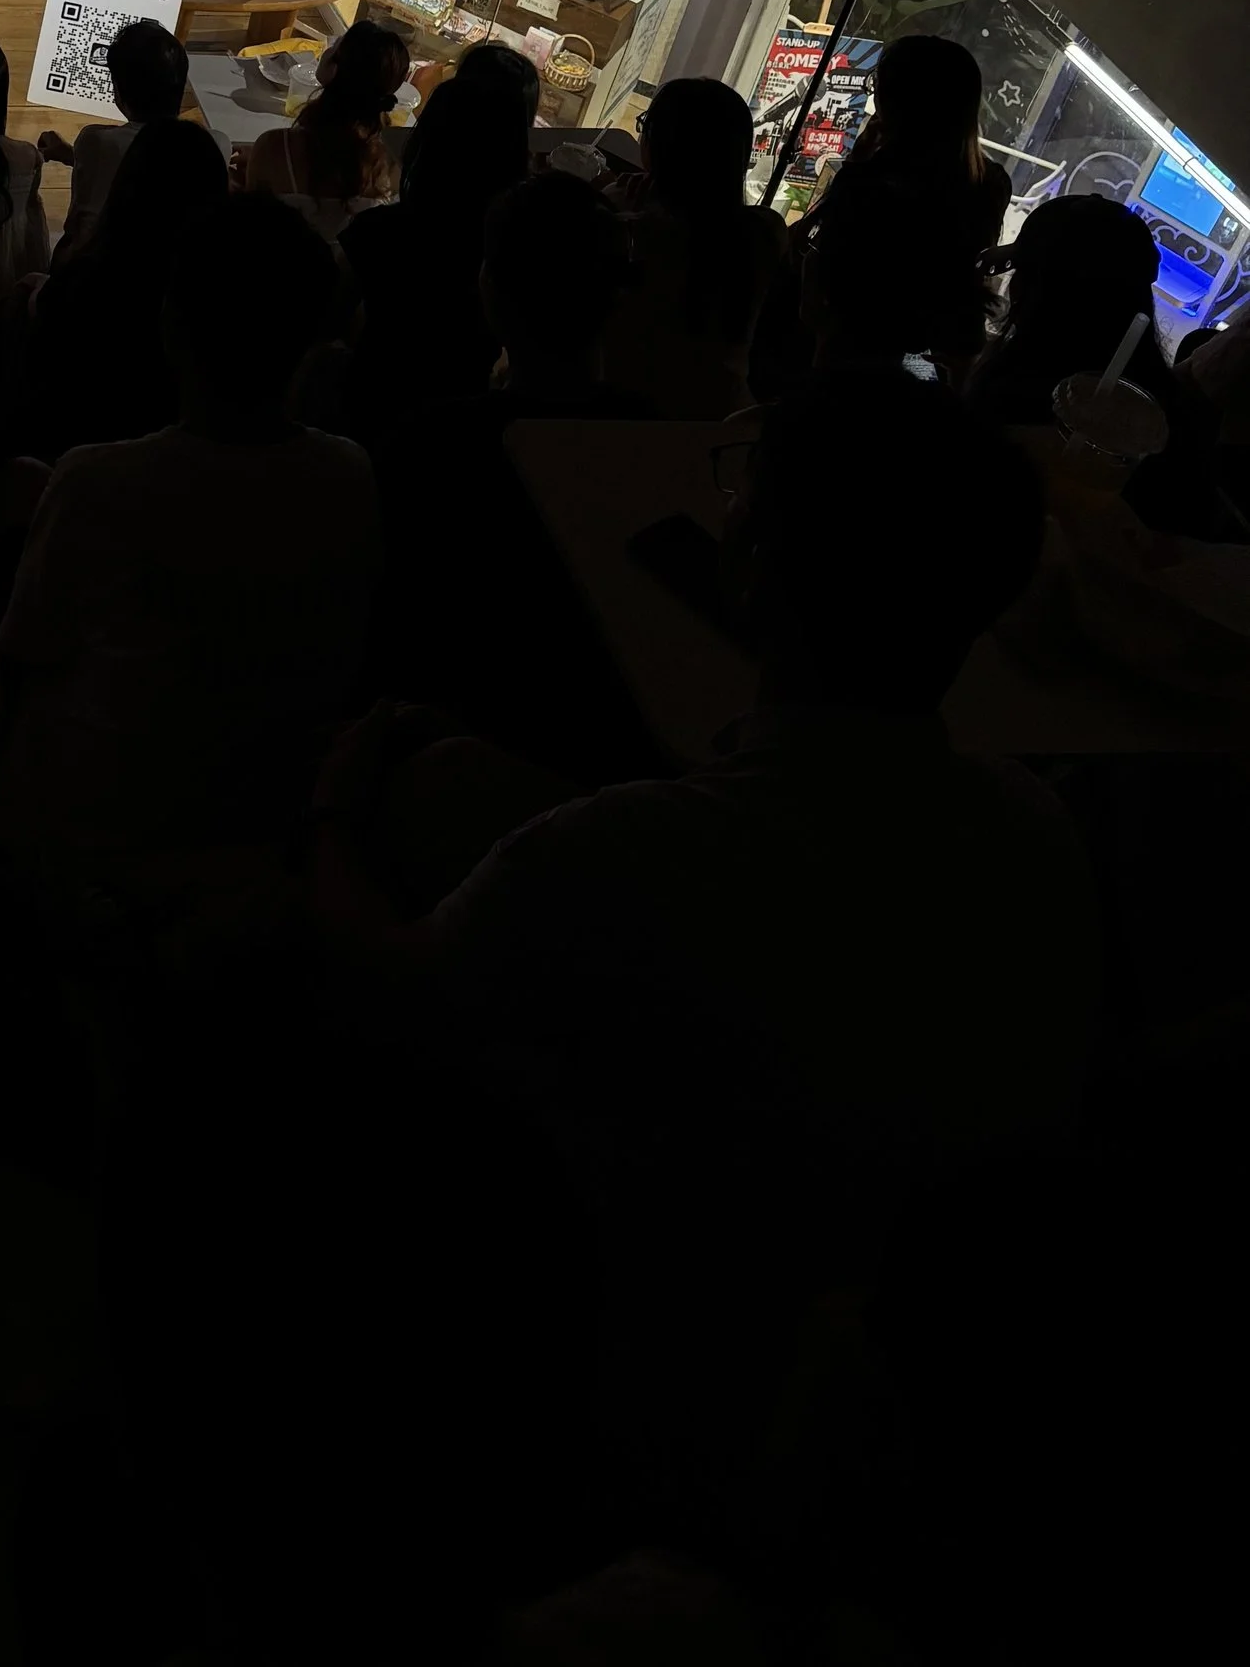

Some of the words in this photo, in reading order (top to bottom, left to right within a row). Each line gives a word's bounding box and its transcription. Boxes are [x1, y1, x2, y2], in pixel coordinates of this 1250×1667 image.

[776, 37, 821, 48] STAND-UP
[774, 52, 842, 71] COMEY
[831, 74, 850, 85] OPEN
[808, 132, 827, 143] 8:30
[828, 133, 842, 144] PM
